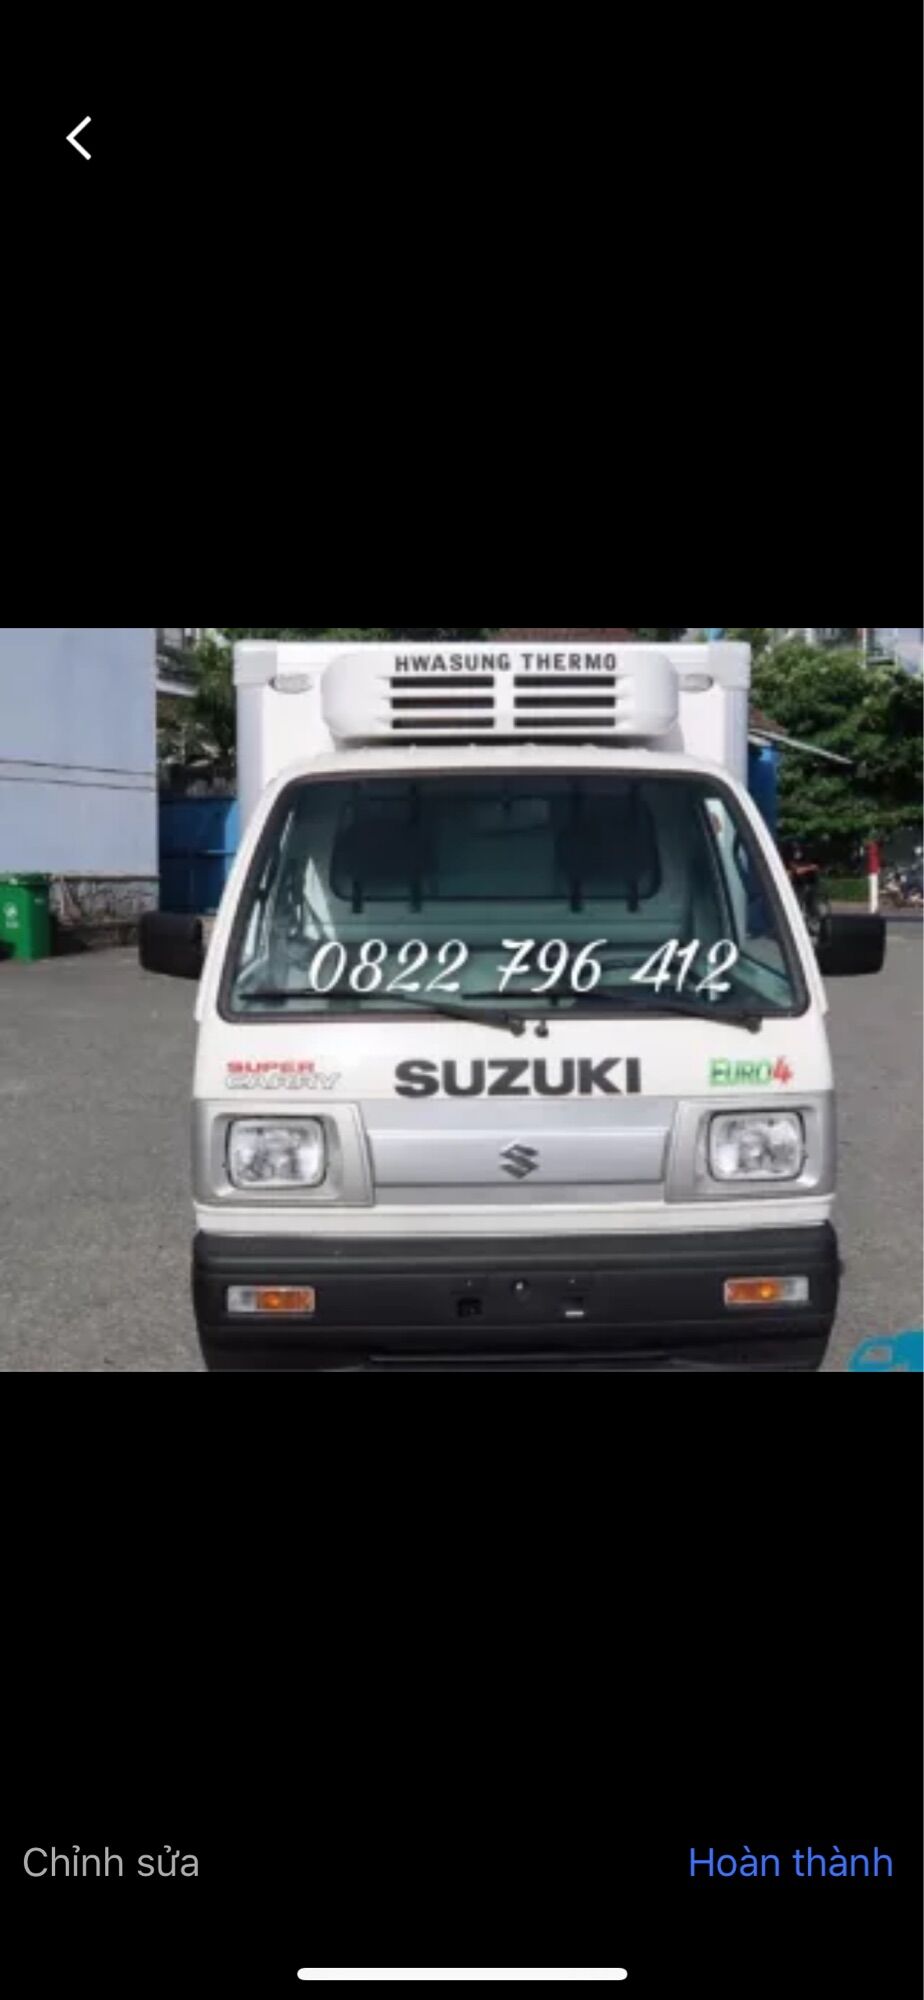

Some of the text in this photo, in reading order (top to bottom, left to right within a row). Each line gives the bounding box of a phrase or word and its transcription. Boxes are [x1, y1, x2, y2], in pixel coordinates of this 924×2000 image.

[395, 653, 617, 672] HWASUNG THERMO
[226, 1060, 315, 1073] SUPER
[394, 1057, 642, 1098] SUZUKI
[225, 1072, 342, 1090] CARRY
[24, 1845, 198, 1877] Chỉnh sửa
[691, 1846, 892, 1876] Hoàn thành
